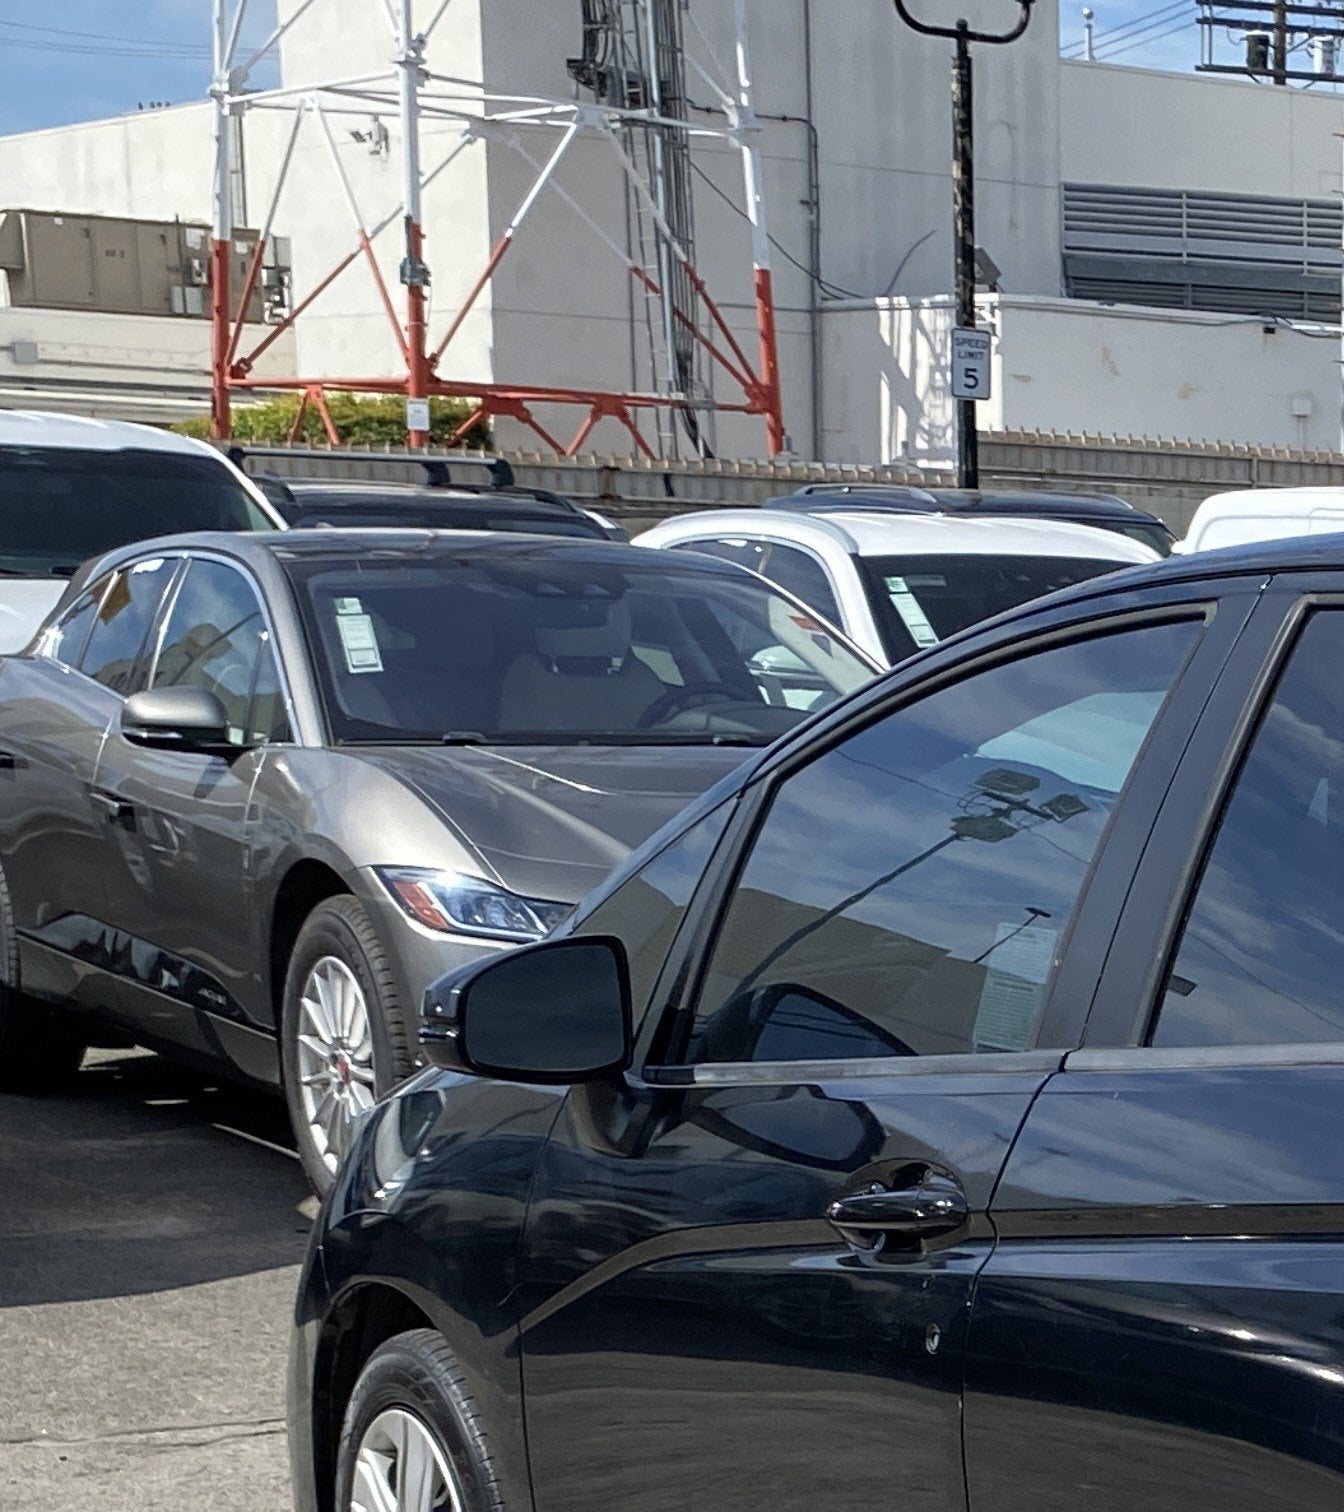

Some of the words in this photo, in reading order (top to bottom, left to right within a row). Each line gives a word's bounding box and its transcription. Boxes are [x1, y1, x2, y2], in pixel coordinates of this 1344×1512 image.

[955, 337, 988, 349] SPEED
[957, 351, 985, 361] LIMIT
[964, 368, 979, 389] 5
